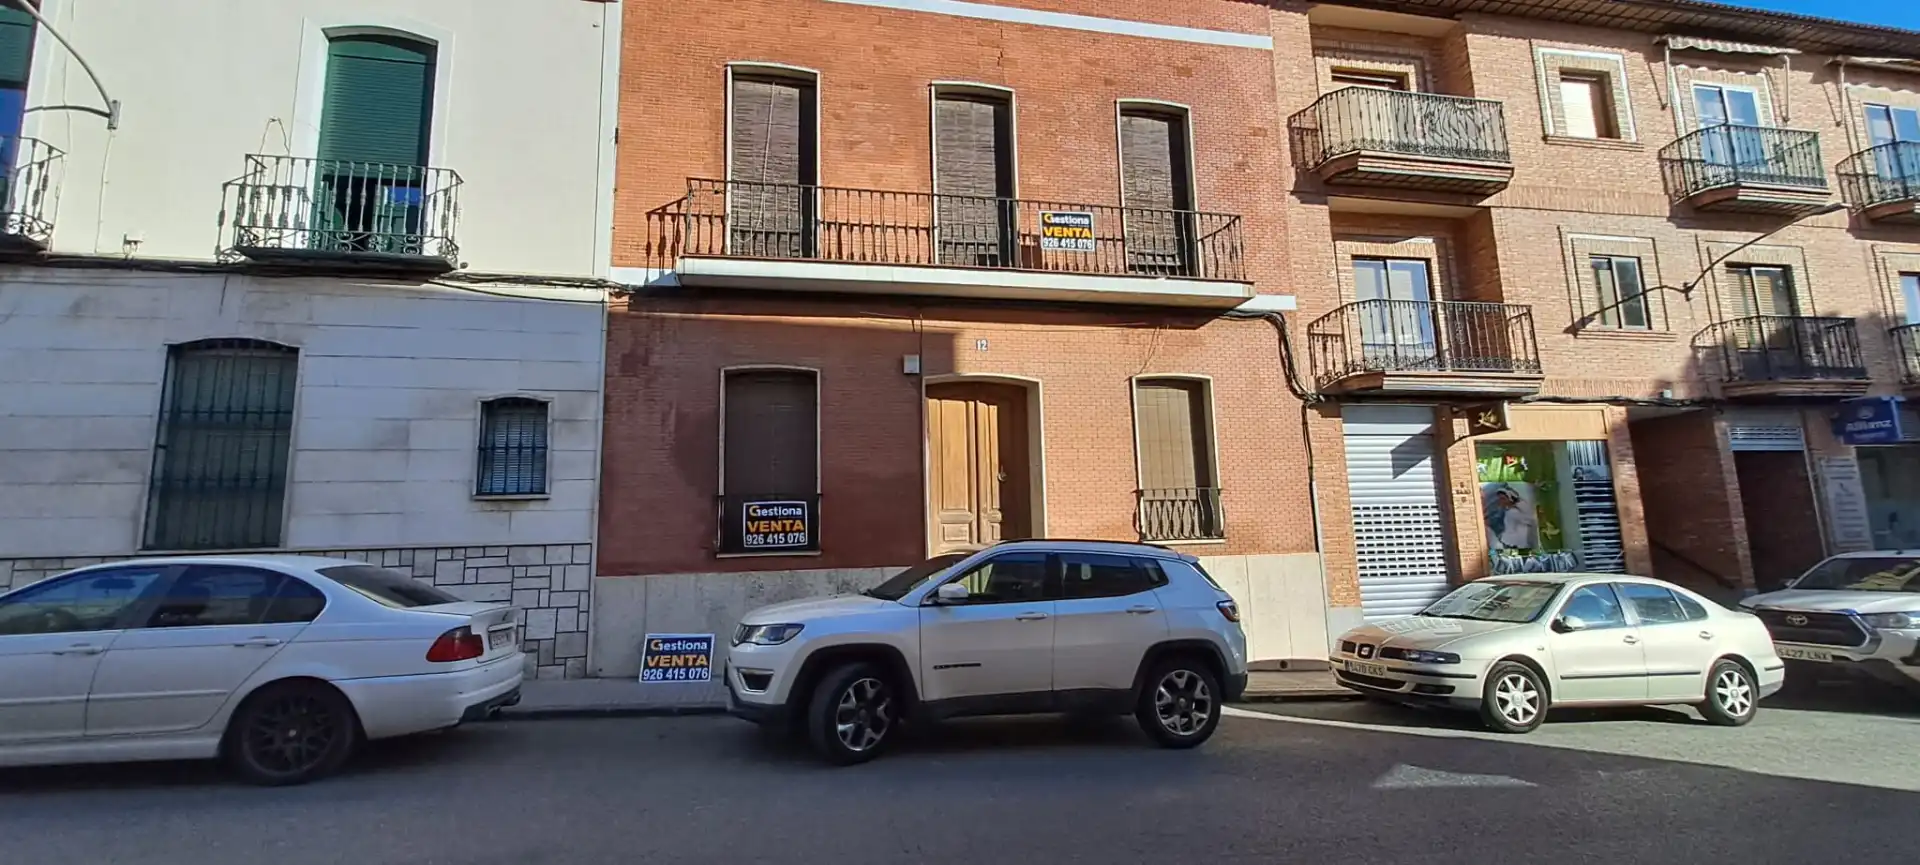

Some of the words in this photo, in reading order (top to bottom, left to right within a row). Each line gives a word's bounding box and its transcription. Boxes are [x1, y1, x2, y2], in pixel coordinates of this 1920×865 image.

[1044, 213, 1089, 225] Gestiona
[1043, 226, 1092, 238] VENTA
[1043, 238, 1058, 248] 926
[1060, 238, 1076, 248] 415
[1077, 238, 1092, 249] 076
[976, 339, 988, 351] 12
[749, 505, 802, 517] Gestiona
[747, 520, 804, 532] VENTA
[747, 534, 764, 545] 926
[766, 533, 785, 544] 415
[787, 532, 805, 543] 076
[650, 640, 708, 651] Gestiona
[646, 654, 708, 667] VENTA
[643, 669, 663, 680] 926
[665, 668, 686, 679] 415
[689, 667, 708, 679] 076
